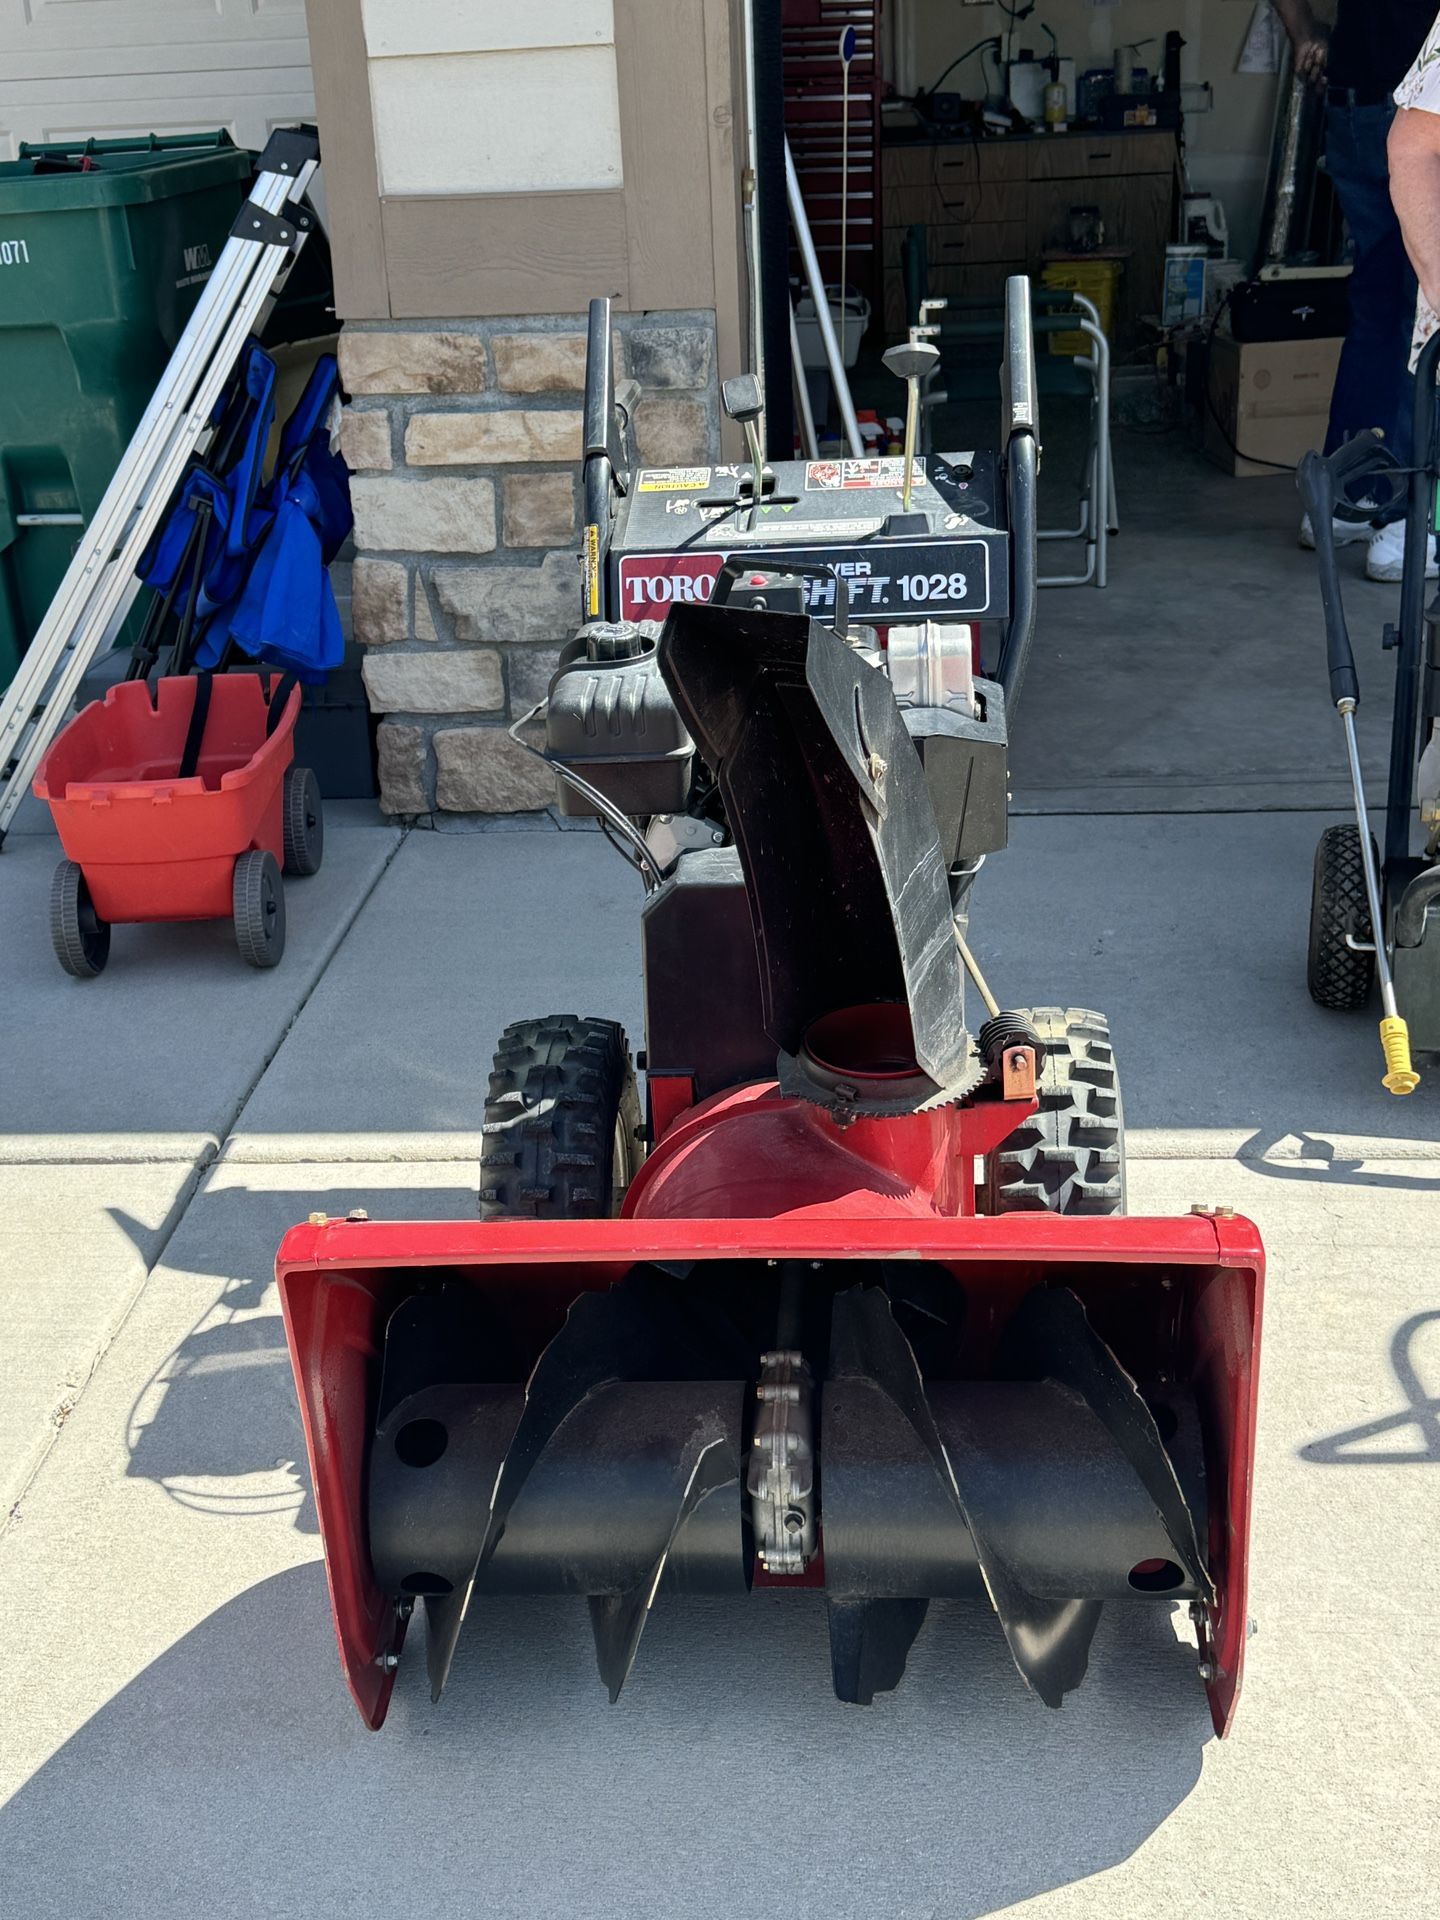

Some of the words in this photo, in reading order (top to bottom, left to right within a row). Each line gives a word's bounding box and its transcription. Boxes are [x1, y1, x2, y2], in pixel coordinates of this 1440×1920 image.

[0, 240, 29, 265] 071
[625, 574, 716, 604] TORO
[896, 573, 968, 601] 1028
